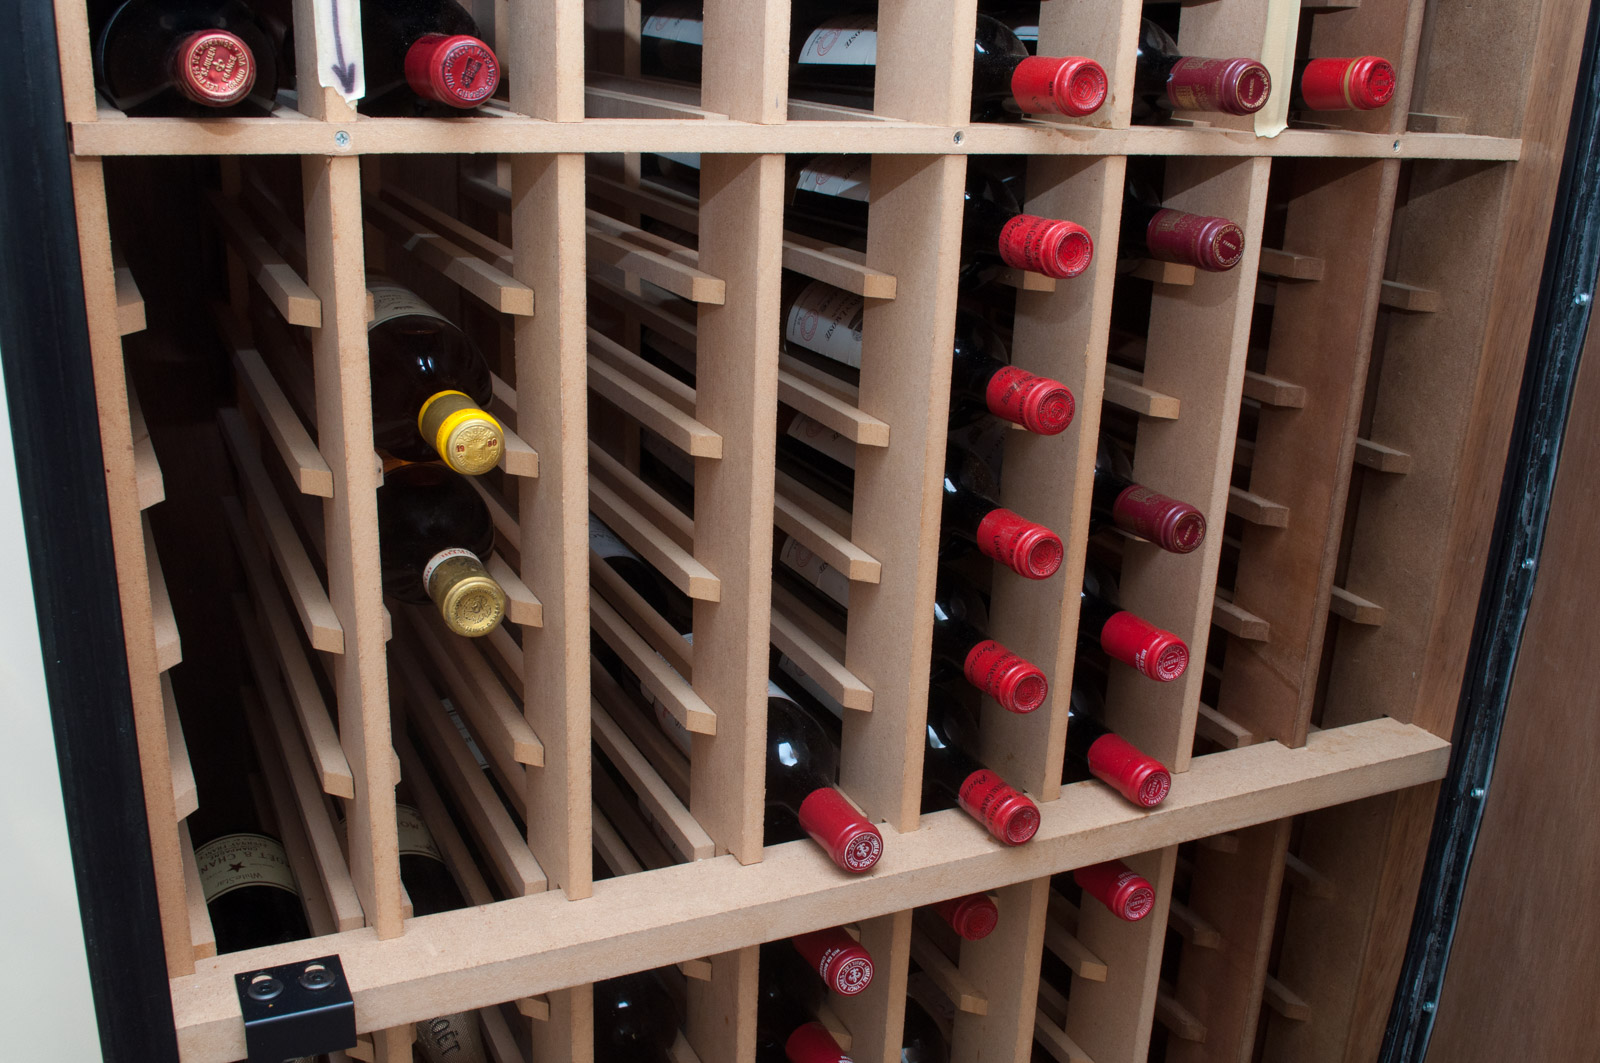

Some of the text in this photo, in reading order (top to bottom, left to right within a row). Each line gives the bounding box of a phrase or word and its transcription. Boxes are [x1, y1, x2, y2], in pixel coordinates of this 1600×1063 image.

[221, 54, 238, 83] FRANCE
[227, 69, 246, 89] GRAND
[859, 854, 877, 868] LYNCH
[846, 980, 865, 992] LYNCH
